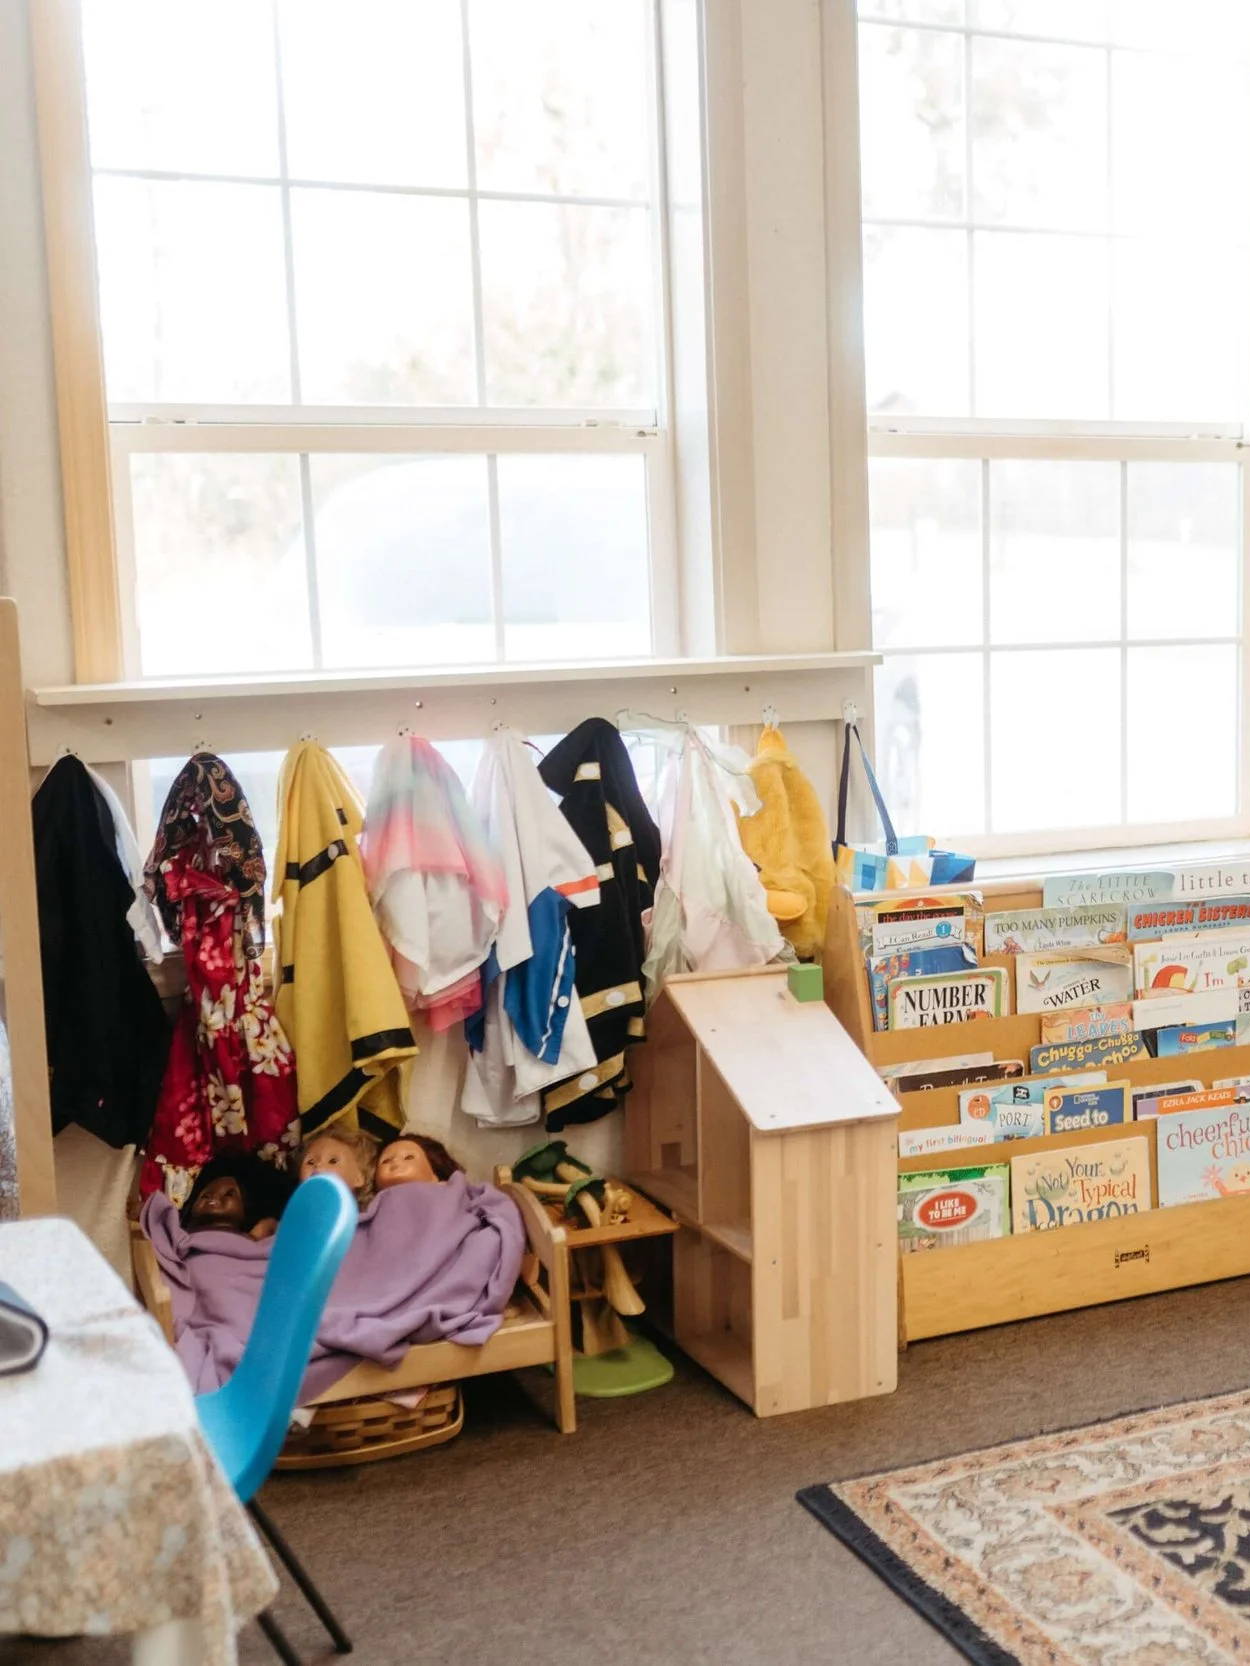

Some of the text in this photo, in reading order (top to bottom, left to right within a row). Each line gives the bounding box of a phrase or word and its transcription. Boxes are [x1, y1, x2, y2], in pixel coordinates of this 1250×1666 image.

[1097, 874, 1151, 890] LITTLE
[1180, 870, 1234, 892] little
[993, 912, 1117, 935] TOO MANY PUMPKINS
[1133, 908, 1195, 929] CHICKEN
[911, 929, 934, 940] Read!
[1204, 971, 1224, 988] I'm
[904, 982, 987, 1014] NUMBER
[1043, 978, 1101, 1008] WATER
[1067, 1017, 1129, 1041] LEAVES
[1037, 1032, 1140, 1067] Chugga-Chugga
[1163, 1090, 1232, 1109] EZRA JACK KEATS
[999, 1111, 1032, 1128] PORT
[1055, 1109, 1109, 1131] Seed to
[908, 1134, 988, 1154] my first bilingual
[1064, 1156, 1105, 1178] Your
[1041, 1172, 1066, 1191] Not
[1073, 1172, 1137, 1209] Typical
[928, 1205, 967, 1220] TO BE ME
[940, 1198, 960, 1208] LIKE
